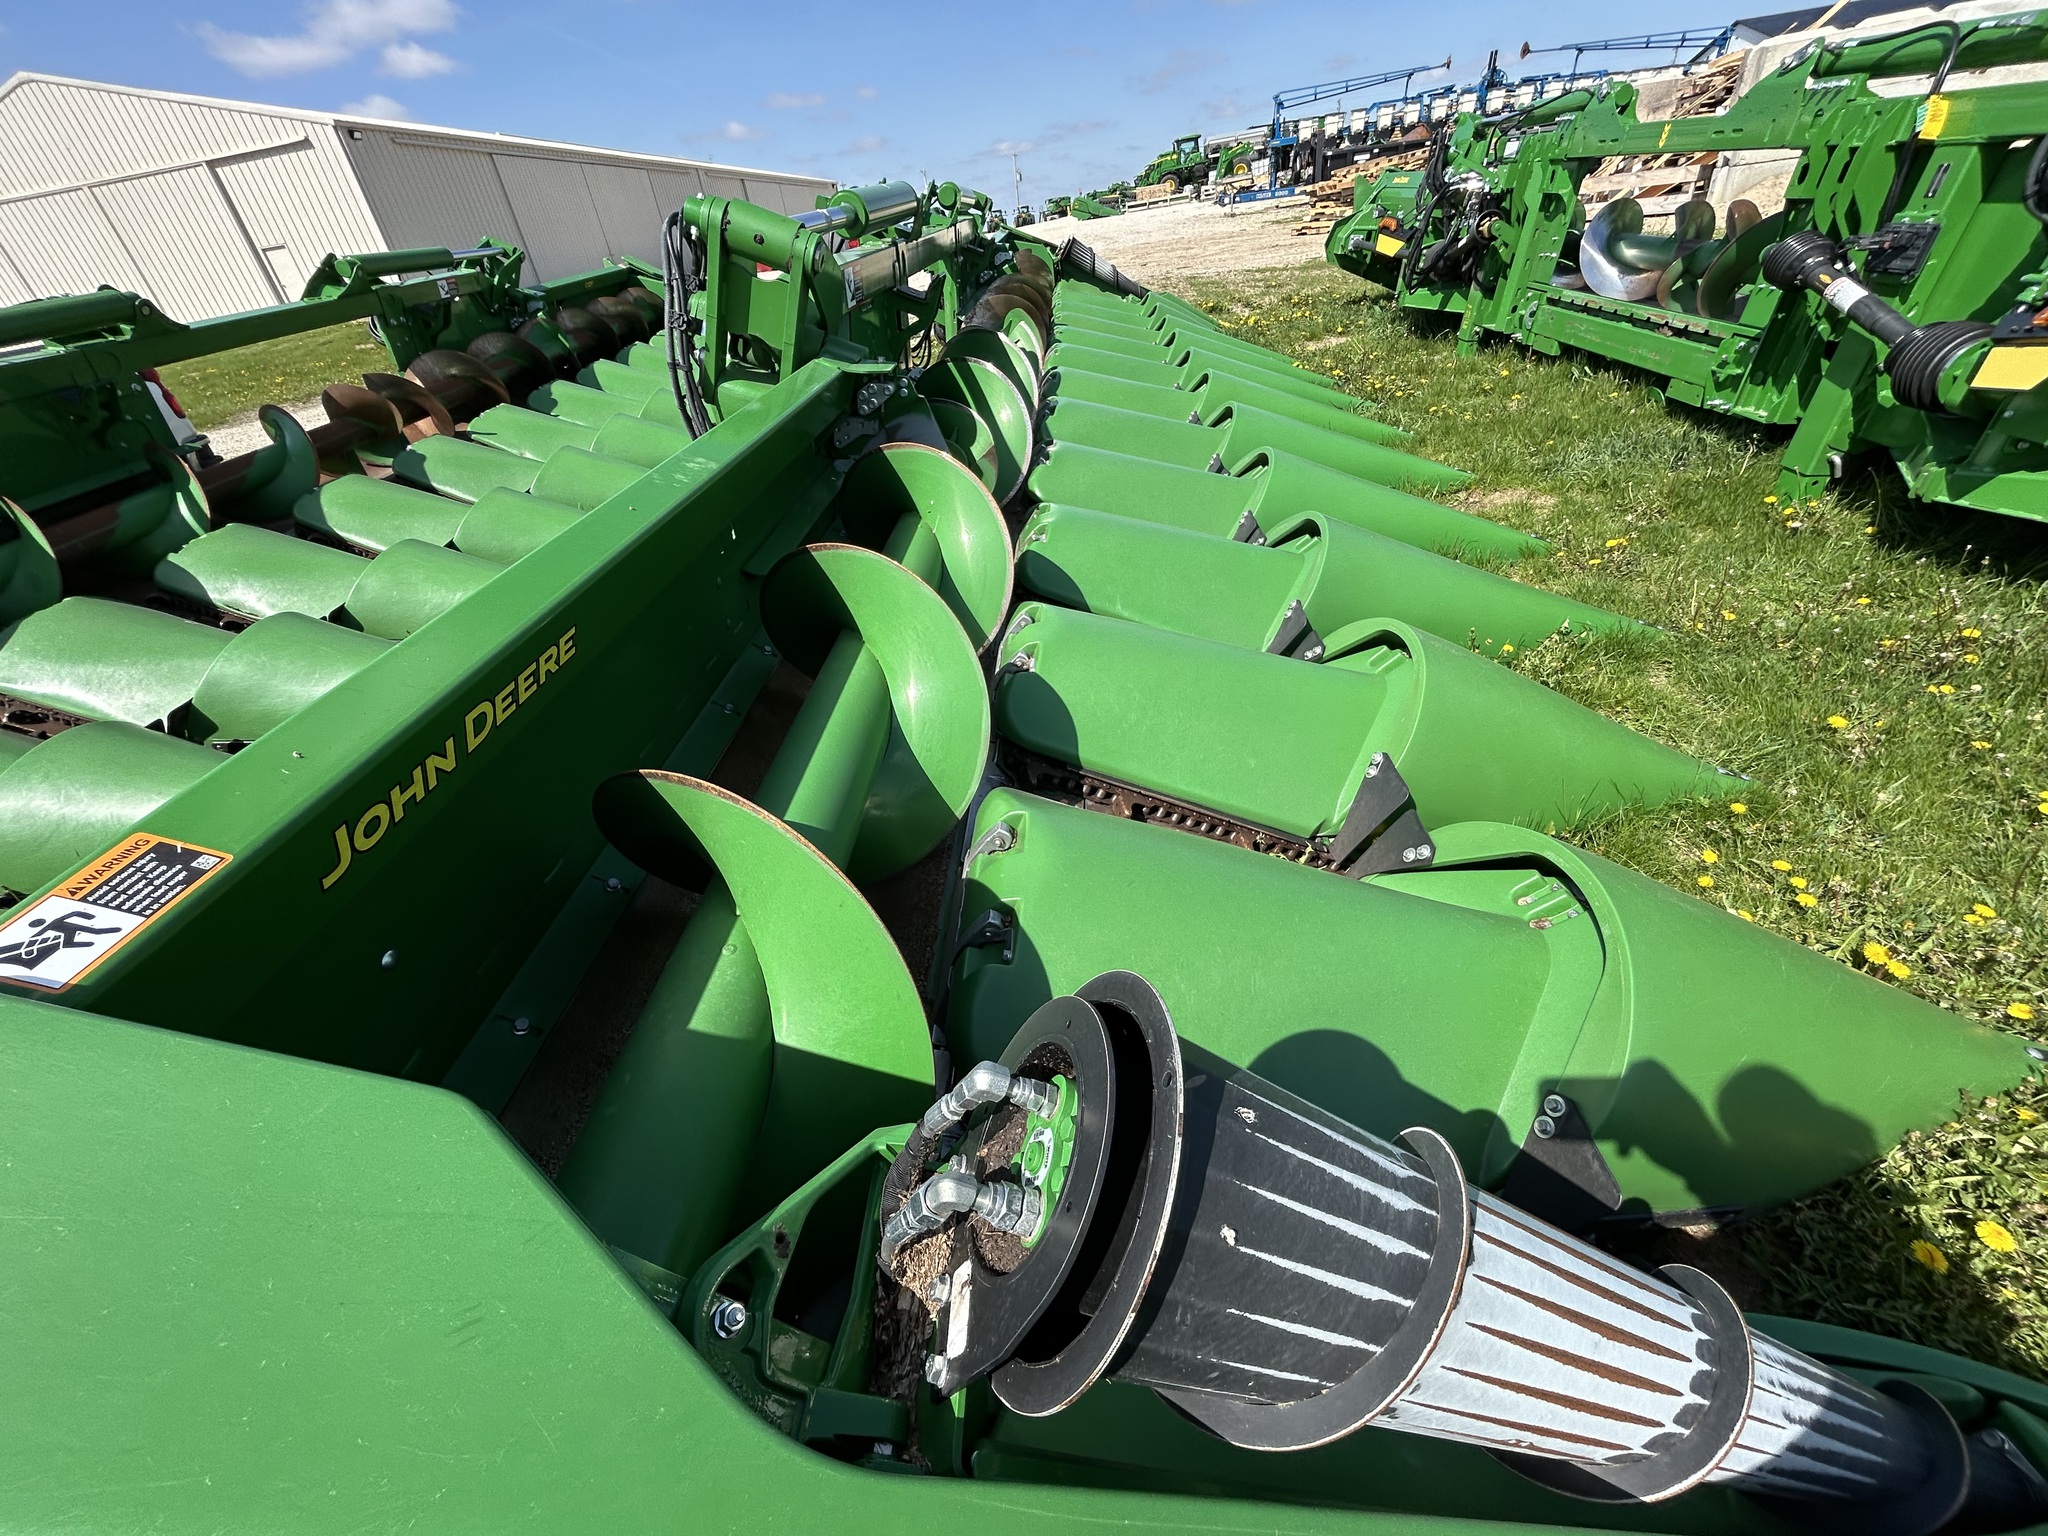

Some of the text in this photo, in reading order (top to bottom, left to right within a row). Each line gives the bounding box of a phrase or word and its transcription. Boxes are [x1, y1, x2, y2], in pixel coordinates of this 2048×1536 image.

[320, 625, 577, 891] JOHN DEERE
[77, 838, 151, 884] WARNING
[97, 861, 159, 904] from contact with
[87, 886, 110, 901] Avoid
[108, 867, 136, 885] serious
[108, 894, 128, 906] feed
[146, 865, 167, 878] Keep
[121, 865, 182, 909] adequate distance
[132, 870, 188, 912] when feed auger
